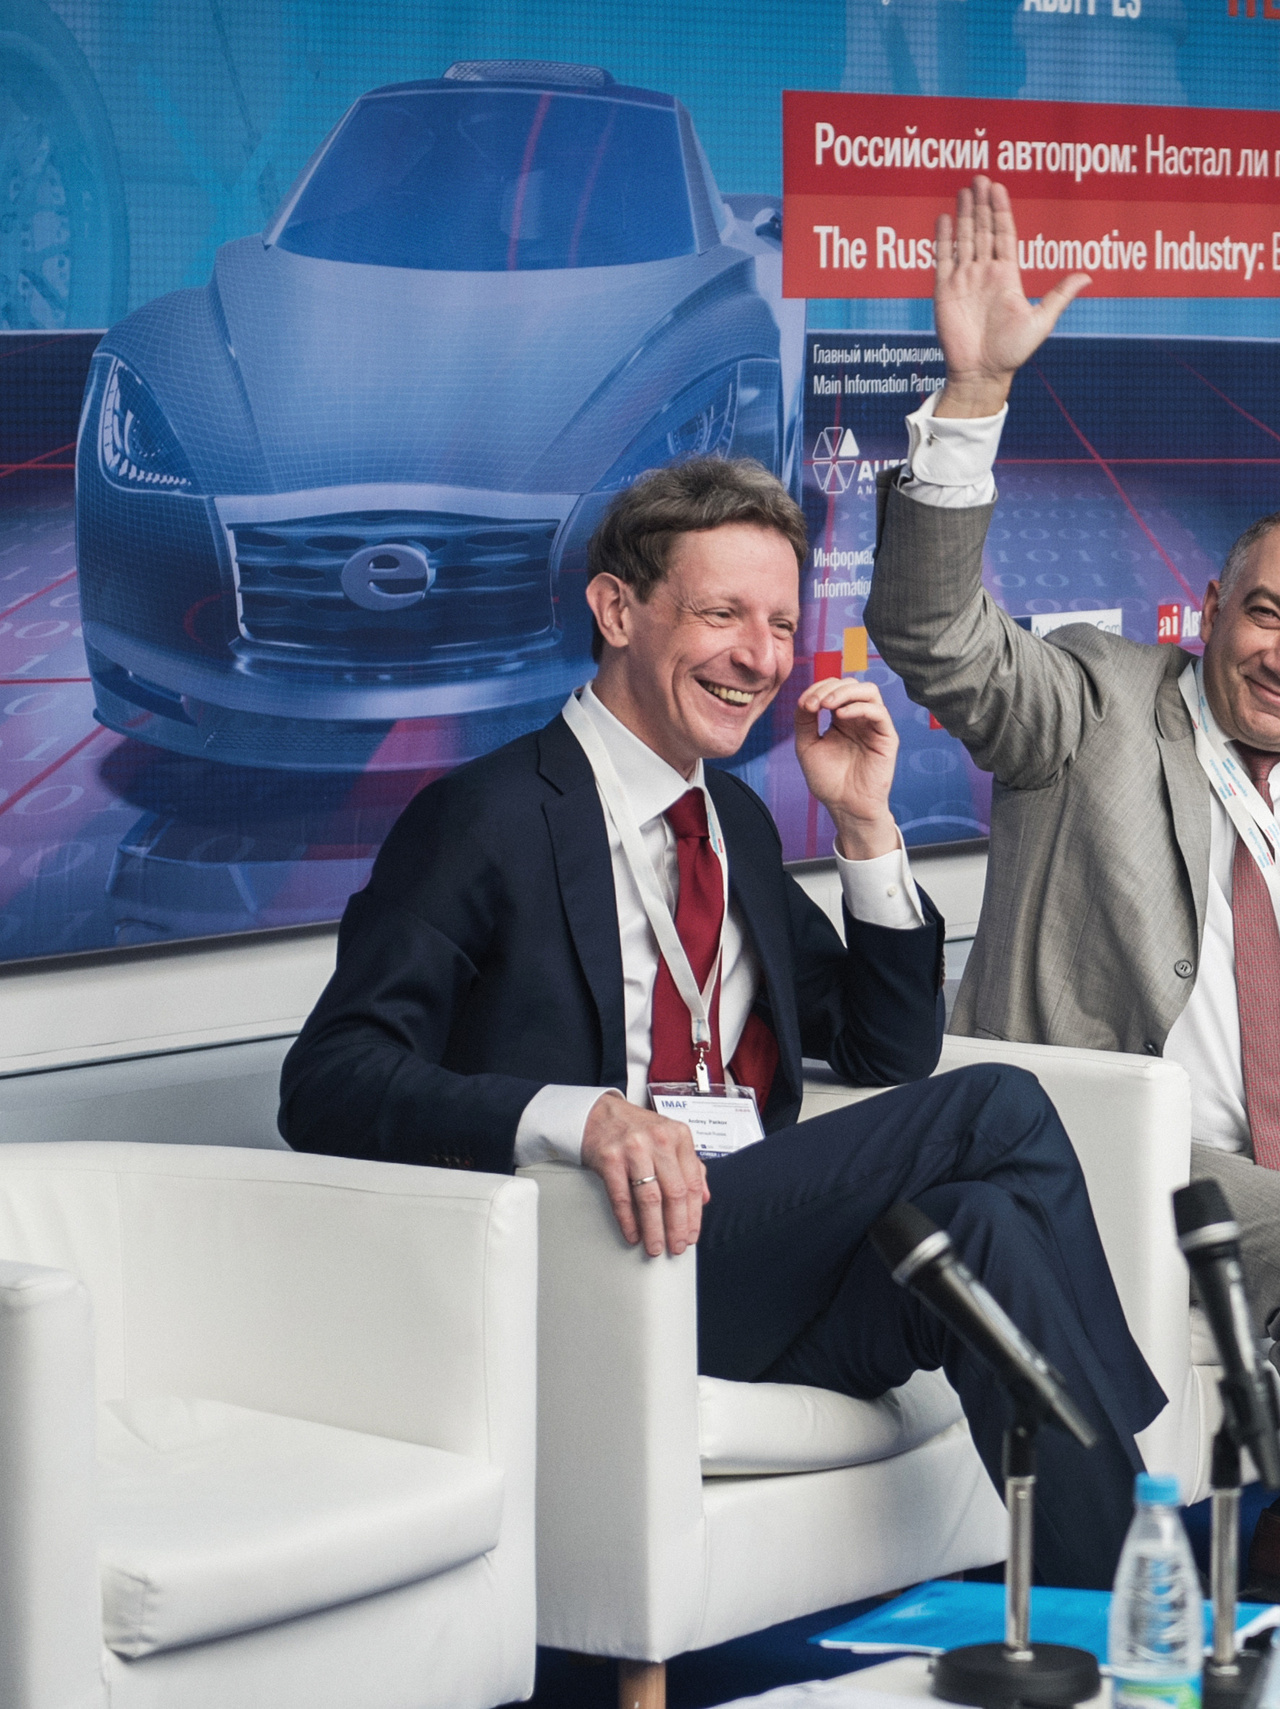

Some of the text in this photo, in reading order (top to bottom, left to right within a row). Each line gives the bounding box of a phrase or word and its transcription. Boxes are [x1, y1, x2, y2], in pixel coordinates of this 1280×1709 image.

[815, 122, 988, 169] Российский
[997, 139, 1137, 182] автопром:
[1146, 133, 1231, 176] Настал
[1237, 147, 1268, 177] ли
[813, 226, 867, 269] The
[1018, 230, 1146, 270] utomotive
[1155, 230, 1264, 280] Industry:
[813, 344, 861, 364] Главный
[813, 375, 842, 394] Main
[845, 374, 907, 394] Information
[813, 576, 872, 598] Informatio
